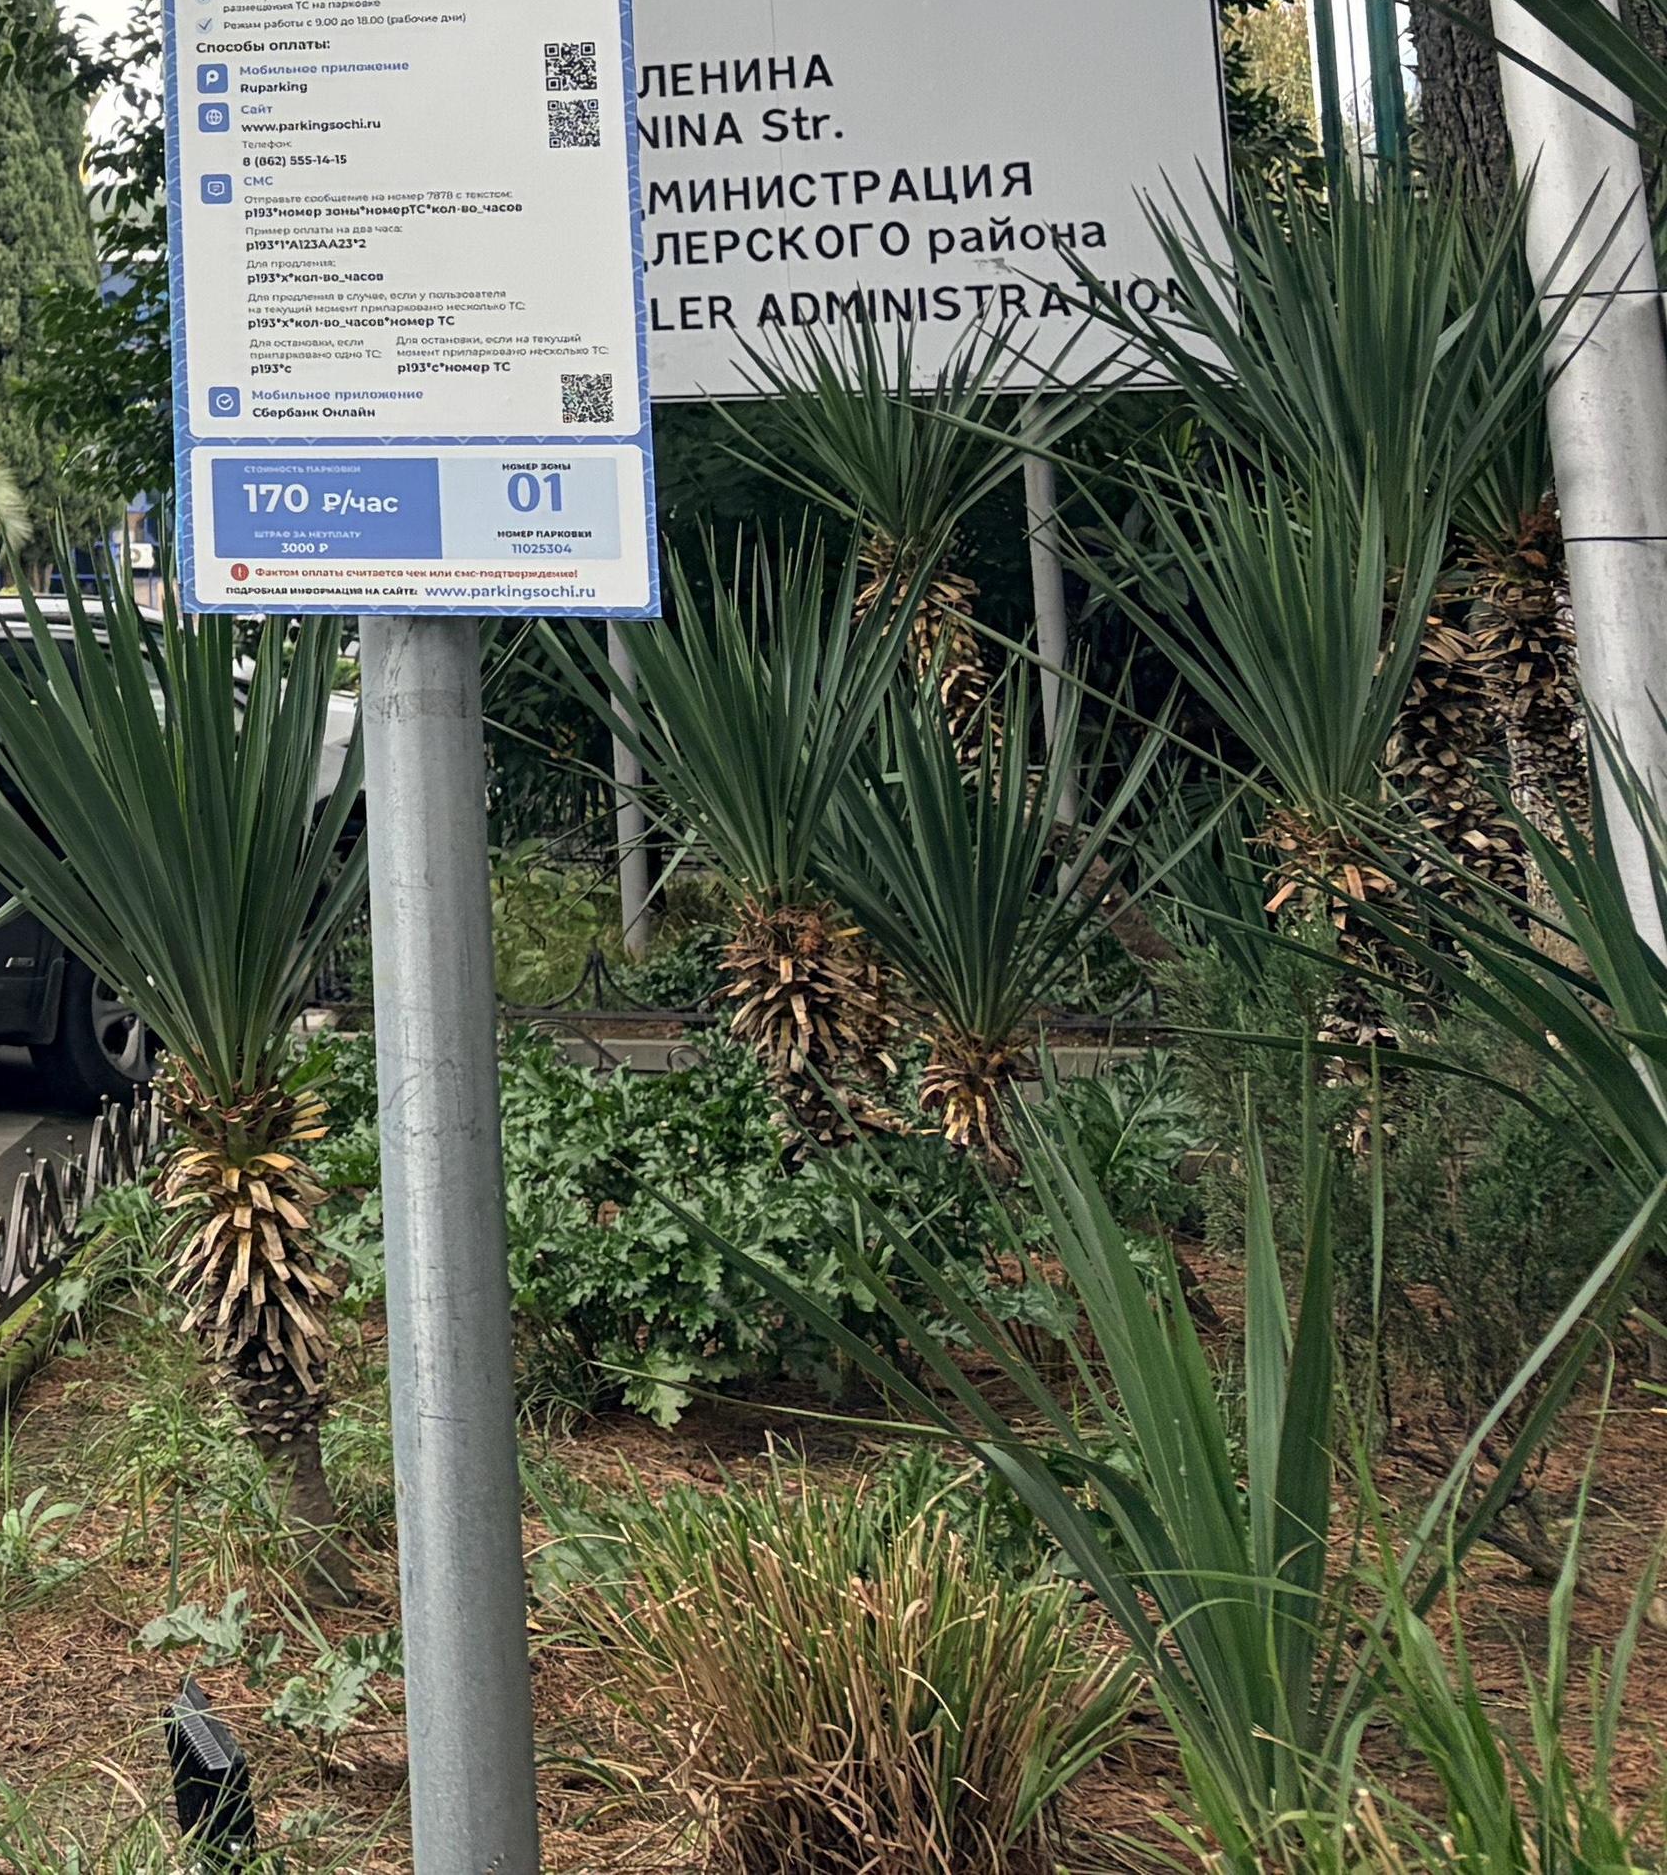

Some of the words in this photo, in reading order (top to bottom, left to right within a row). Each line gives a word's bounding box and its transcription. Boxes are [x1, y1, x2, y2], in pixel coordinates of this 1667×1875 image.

[223, 2, 293, 13] размещения
[296, 1, 309, 10] ТС
[328, 0, 381, 11] парковке
[223, 21, 261, 30] Режим
[264, 18, 303, 31] работы
[315, 17, 338, 26] 9.00
[341, 17, 354, 27] до
[357, 15, 384, 25] 18.00
[387, 14, 438, 25] (рабочие
[441, 12, 466, 23] дни)
[196, 40, 264, 53] Способы
[269, 39, 330, 52] оплаты:
[240, 64, 317, 75] Мобильное
[321, 61, 409, 74] приложение
[637, 54, 833, 99] ЛЕНИНА
[240, 81, 308, 94] Ruparking
[241, 103, 273, 114] Сайт
[241, 118, 381, 133] www.parkingsochi.ru
[762, 106, 843, 143] Str.
[243, 157, 250, 166] 8
[254, 156, 286, 168] (862)
[290, 155, 347, 166] 555-14-15
[244, 176, 273, 186] СМС
[641, 161, 1032, 221] МИНИСТРАЦИЯ
[244, 195, 301, 205] Отправьте
[304, 193, 368, 204] сообщение
[388, 194, 424, 203] номер
[245, 226, 290, 236] Пример
[293, 226, 333, 235] оплаты
[352, 226, 373, 234] два
[643, 221, 910, 272] ЛЕРСКОГО
[928, 215, 1107, 264] района
[246, 260, 268, 270] Для
[248, 293, 269, 303] Для
[272, 293, 334, 302] продления
[346, 292, 387, 302] случае,
[390, 292, 417, 300] если
[419, 292, 426, 301] у
[429, 290, 506, 300] пользователя
[264, 304, 312, 315] текущий
[315, 305, 358, 313] момент
[361, 303, 443, 314] припарковано
[446, 302, 506, 311] несколько
[438, 315, 455, 326] ТС
[249, 339, 271, 349] Для
[273, 339, 335, 348] остановки,
[337, 338, 364, 346] если
[396, 336, 418, 346] Для
[421, 335, 483, 345] остановки,
[485, 335, 513, 343] если
[515, 335, 529, 343] на
[532, 333, 581, 345] текущий
[250, 350, 332, 360] припарковано
[334, 350, 362, 359] одно
[397, 349, 440, 357] момент
[442, 347, 527, 358] припарковано
[529, 347, 589, 356] несколько
[493, 362, 510, 372] ТС
[252, 389, 331, 400] Мобильное
[334, 389, 424, 401] приложение
[252, 407, 319, 420] Сбербанк
[322, 406, 376, 418] Онлайн
[244, 465, 304, 473] СТОИМОСТЬ
[306, 465, 361, 473] ПАРКОВКИ
[502, 463, 538, 471] НОМЕР
[540, 463, 572, 471] ЗОНЫ
[507, 472, 562, 512] 01
[242, 483, 310, 513] 170
[322, 489, 399, 515] ₽/час
[497, 530, 531, 538] НОМЕР
[536, 530, 592, 538] ПАРКОВКИ
[281, 543, 315, 553] 3000
[511, 543, 572, 554] 11025304
[255, 568, 299, 577] Фактом
[302, 569, 343, 577] оплаты
[346, 569, 403, 577] считается
[406, 569, 427, 577] чек
[454, 569, 578, 579] смс-подтверждение!
[226, 587, 288, 595] ПОДРОБНАЯ
[290, 587, 363, 595] ИНФОРМАЦИЯ
[365, 587, 379, 595] НА
[382, 586, 418, 595] САЙТЕ:
[425, 584, 596, 600] www.parkingsochi.ru
